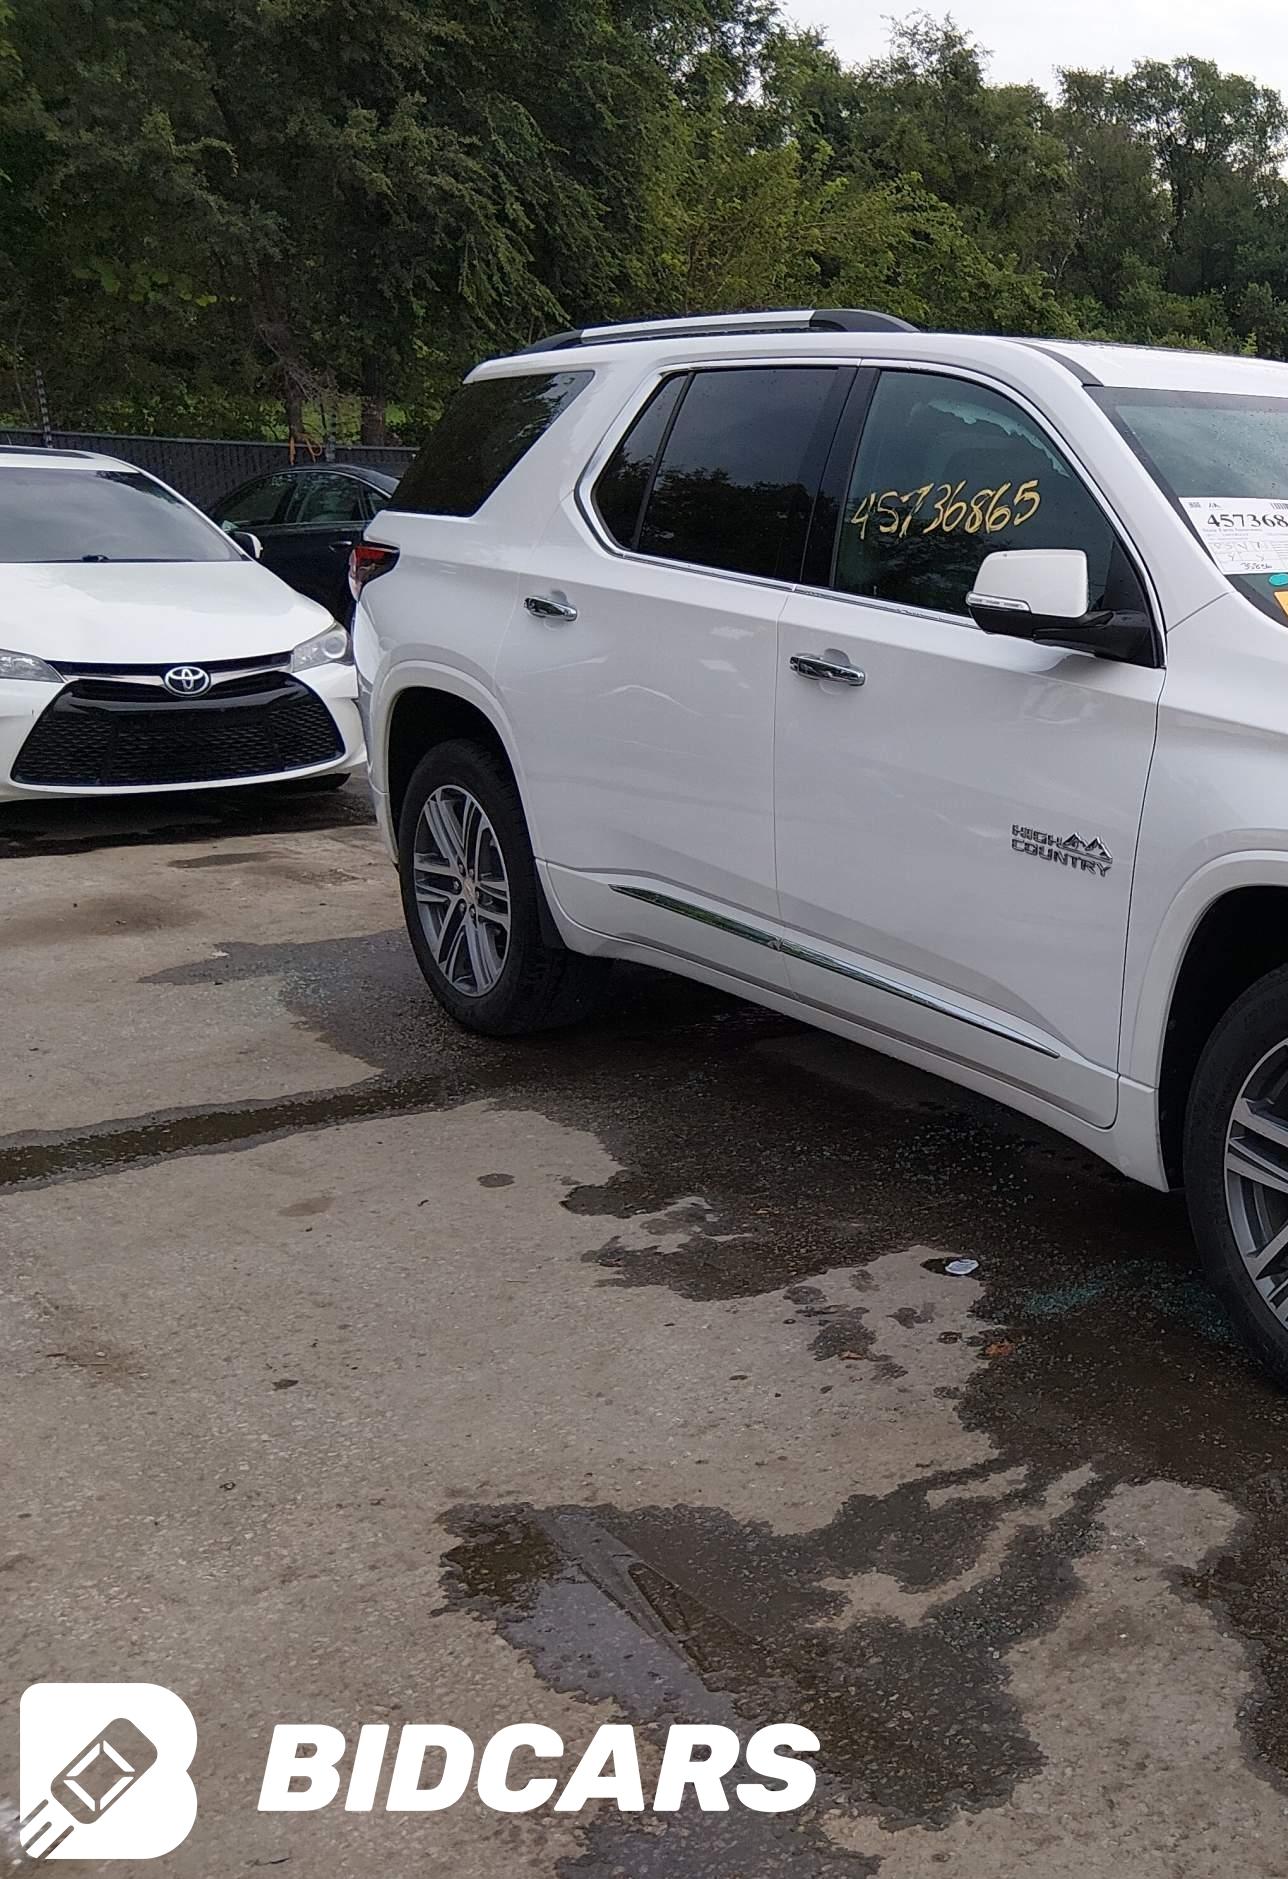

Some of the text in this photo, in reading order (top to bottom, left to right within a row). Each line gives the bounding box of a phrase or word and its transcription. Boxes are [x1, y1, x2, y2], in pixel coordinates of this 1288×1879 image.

[850, 479, 1041, 540] 45736865
[1011, 823, 1063, 849] HIGH
[1011, 838, 1112, 877] COUNTRY
